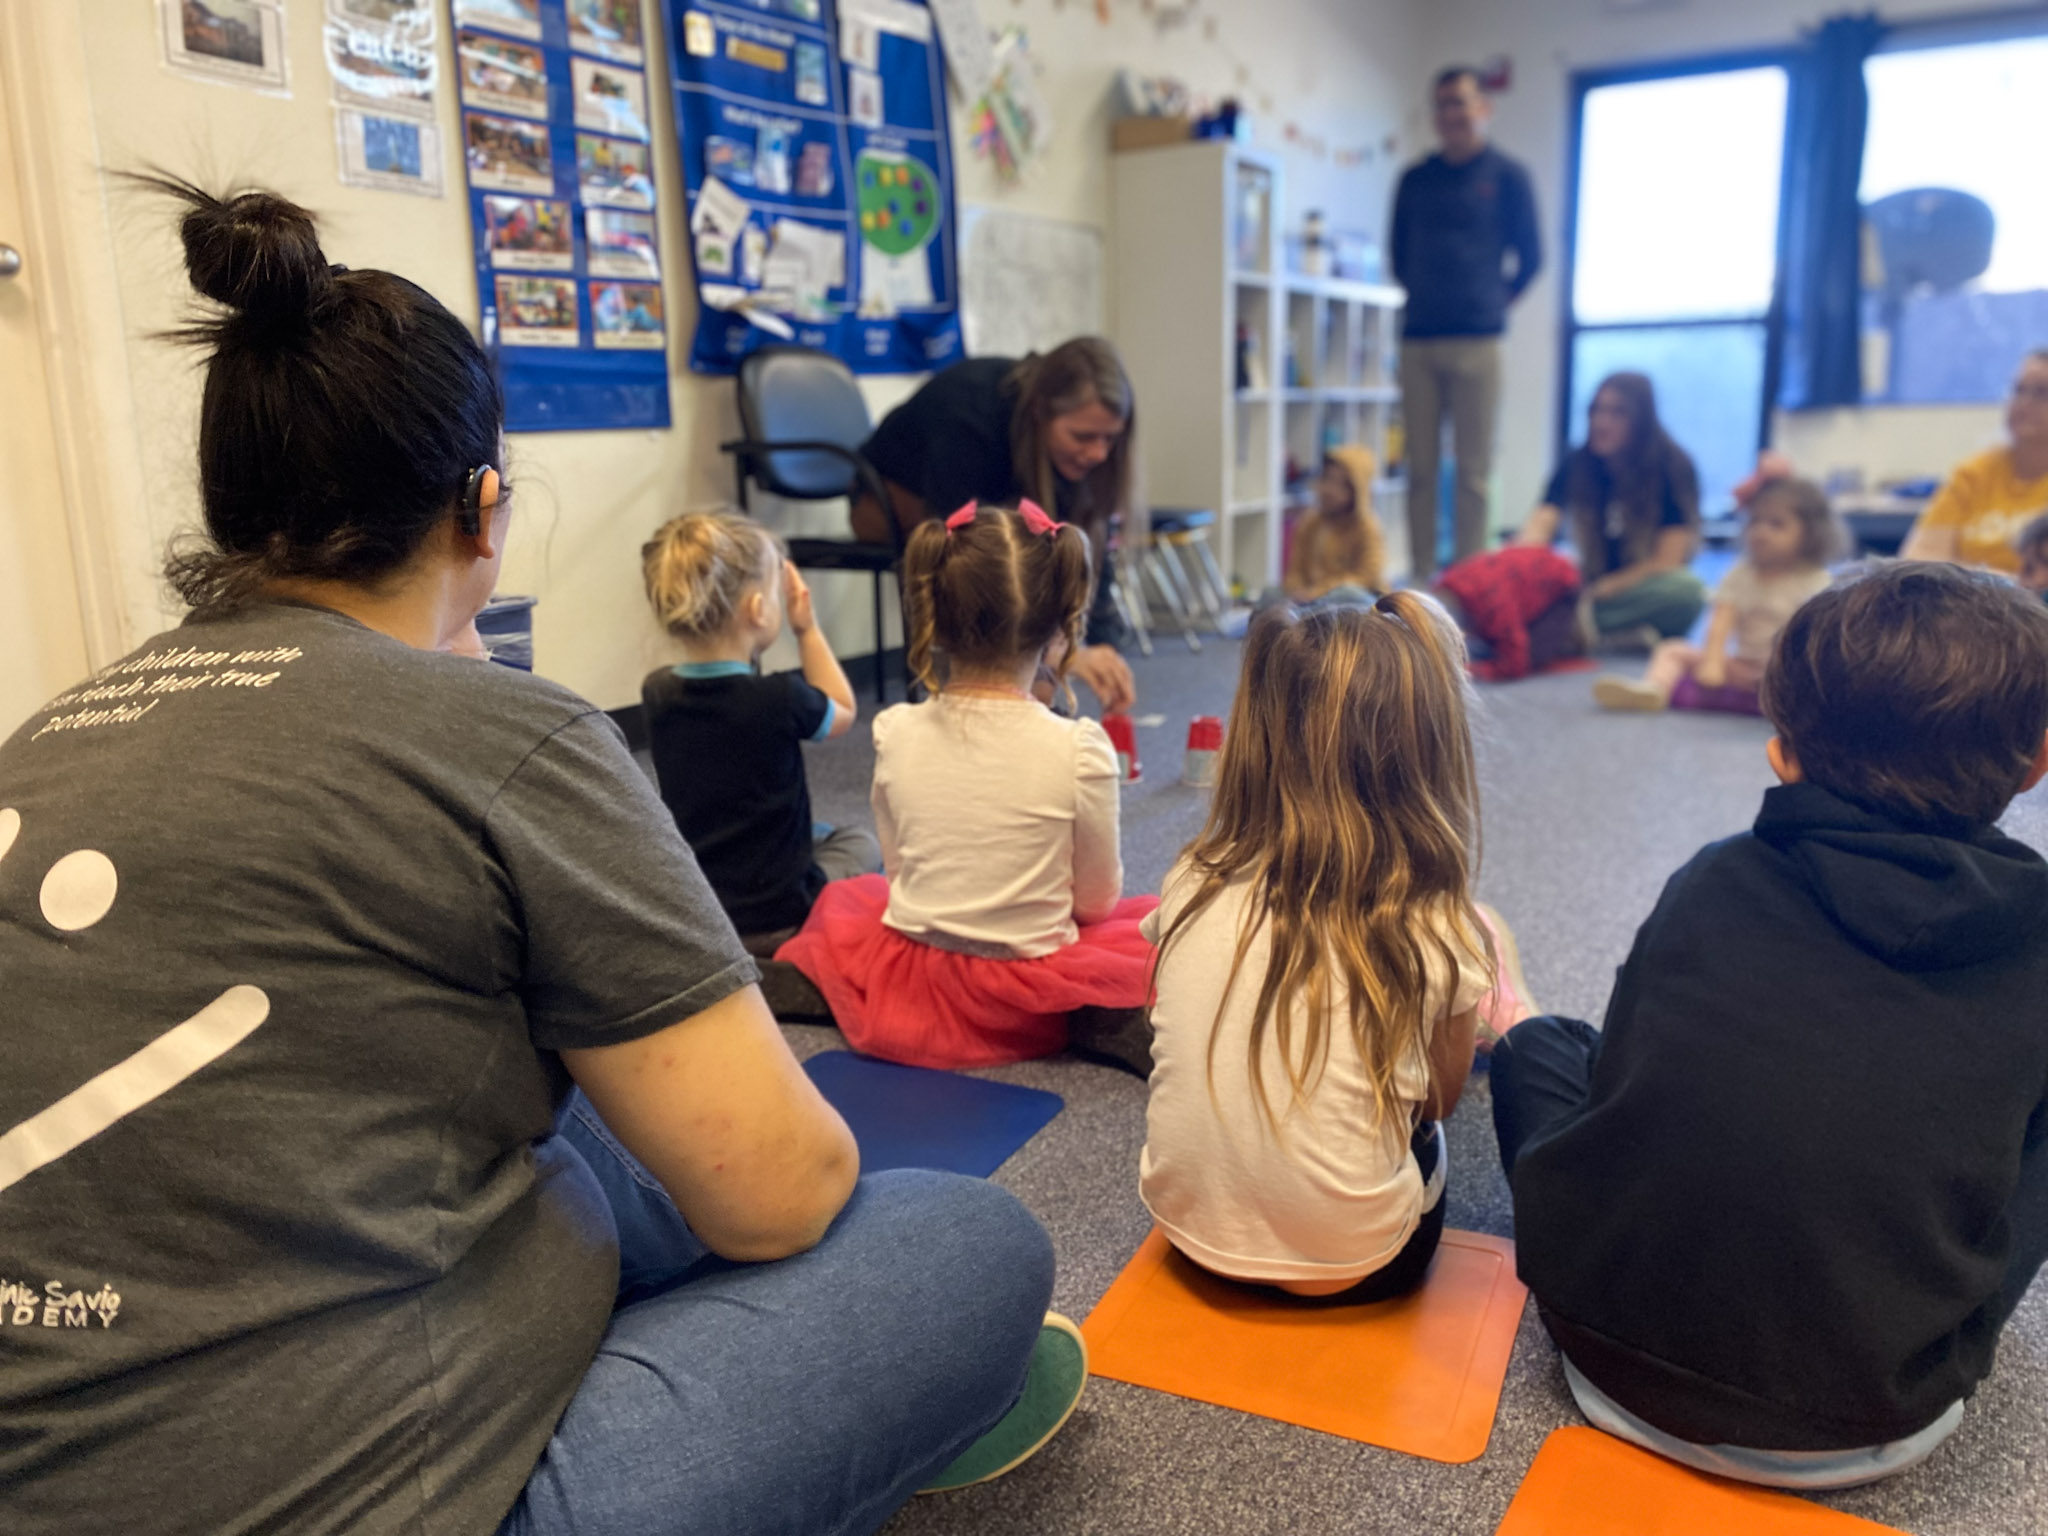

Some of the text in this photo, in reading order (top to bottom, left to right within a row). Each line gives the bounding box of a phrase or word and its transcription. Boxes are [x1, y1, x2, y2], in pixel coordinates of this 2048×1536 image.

[122, 646, 230, 674] children
[229, 646, 304, 664] with
[75, 676, 145, 703] reach
[143, 669, 215, 695] their
[211, 668, 281, 688] true
[31, 698, 159, 741] potential
[44, 1279, 121, 1312] Savio
[0, 1303, 119, 1329] DEMY
